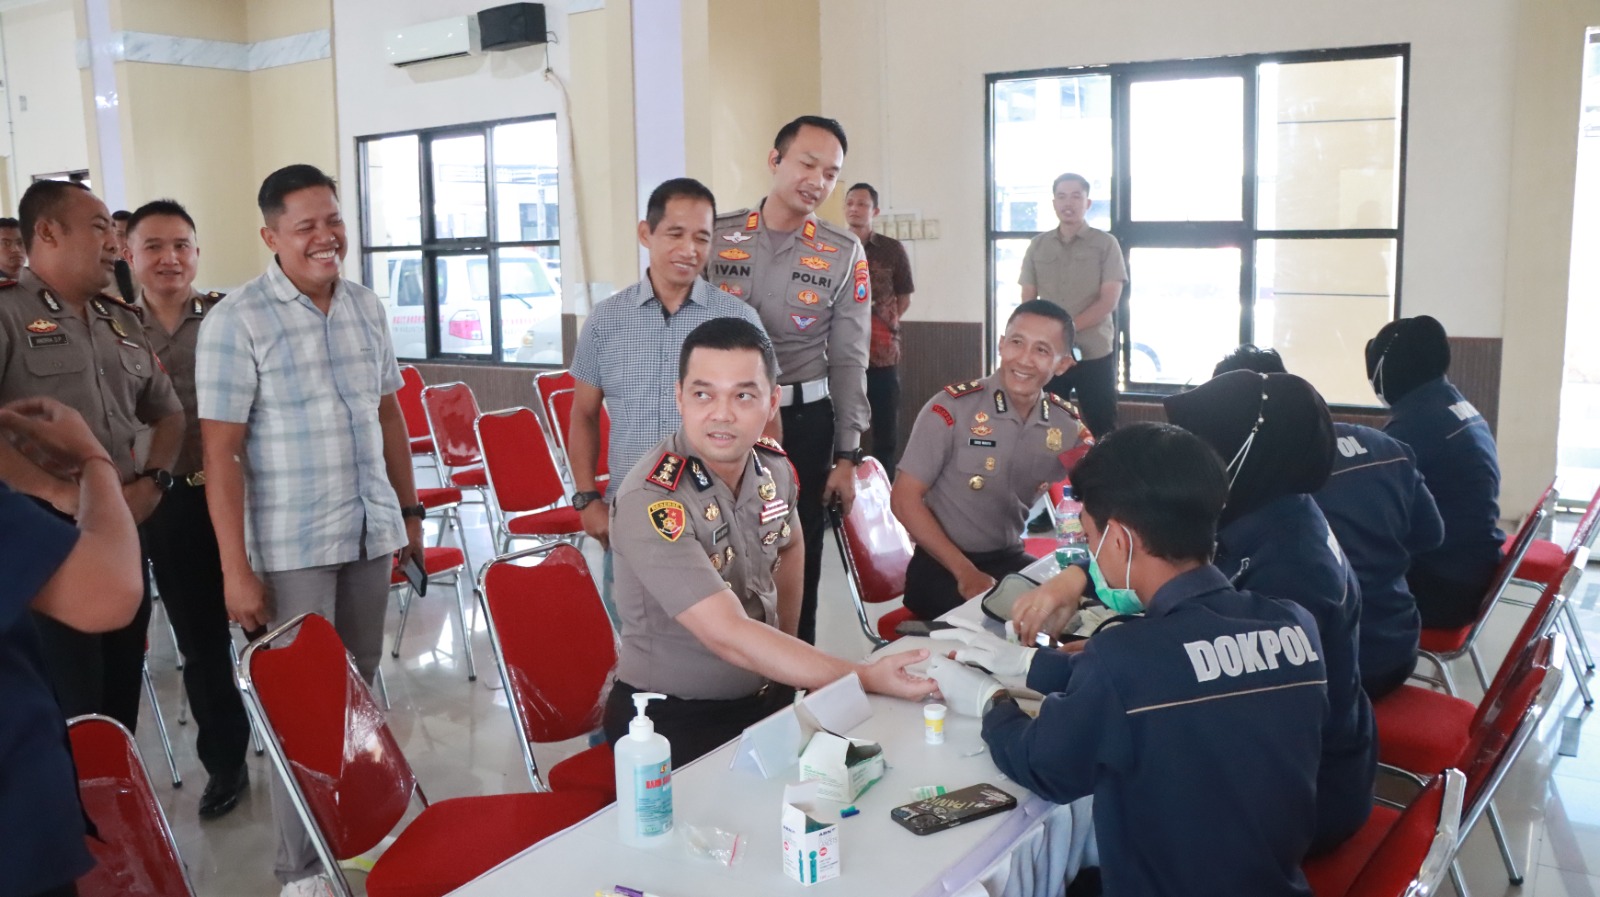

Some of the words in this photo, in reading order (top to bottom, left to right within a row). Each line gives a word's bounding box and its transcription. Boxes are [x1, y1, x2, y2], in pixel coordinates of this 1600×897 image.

[715, 264, 751, 277] IVAN
[791, 271, 832, 288] POLRI
[1183, 625, 1319, 683] DOKPOL
